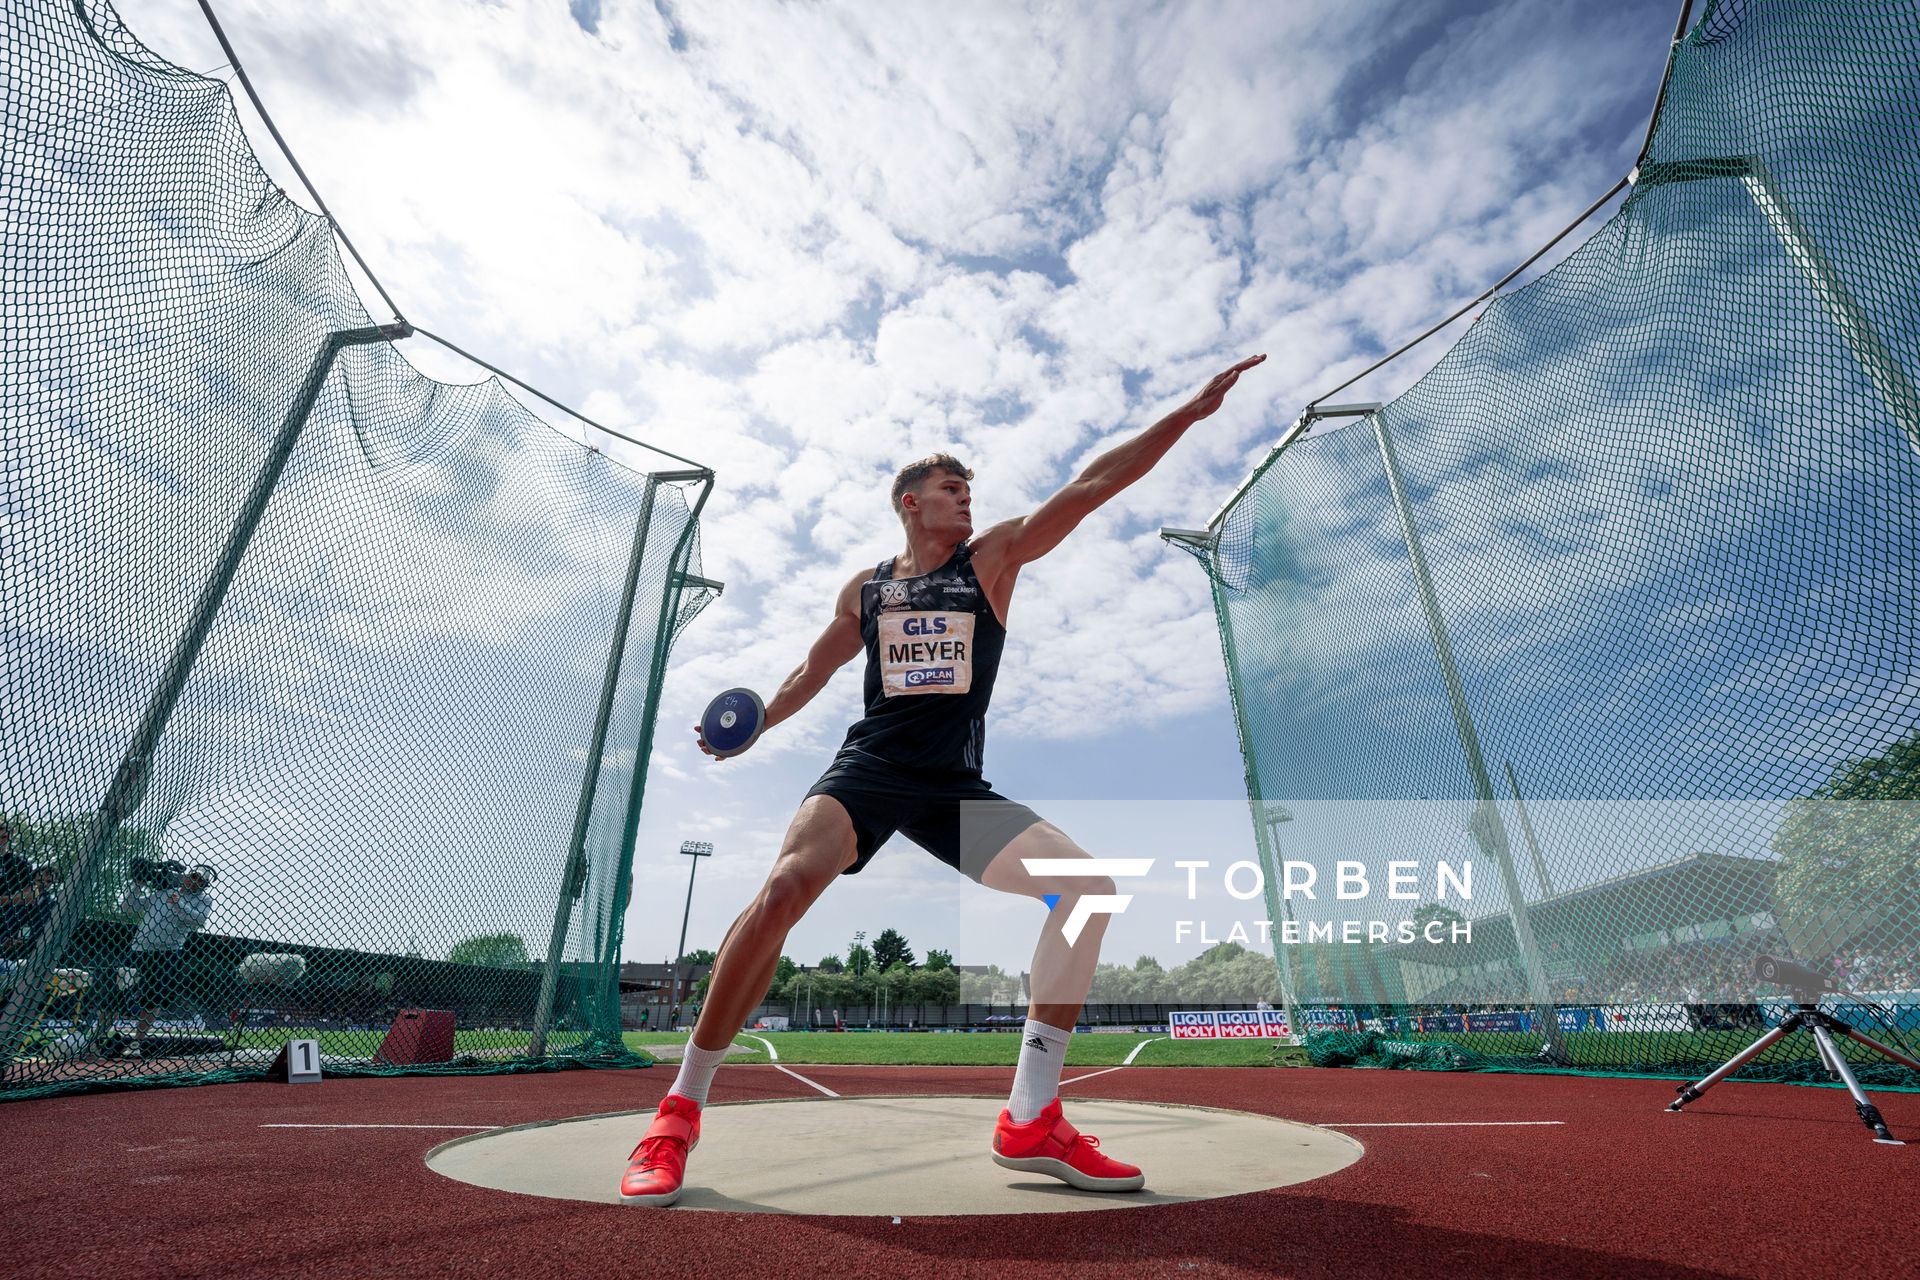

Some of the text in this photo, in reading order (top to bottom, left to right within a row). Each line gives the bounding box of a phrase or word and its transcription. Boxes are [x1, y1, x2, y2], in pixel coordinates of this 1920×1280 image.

[881, 581, 908, 605] 96
[889, 641, 965, 663] MEYER
[926, 670, 953, 680] PLAN
[1174, 1014, 1213, 1025] LIQUI
[1219, 1013, 1258, 1025] LIQUI
[1175, 1026, 1215, 1037] MOLY
[1221, 1025, 1261, 1037] MOLY
[1266, 1025, 1289, 1036] MO
[1025, 1041, 1048, 1053] adidas
[298, 1043, 313, 1071] 1
